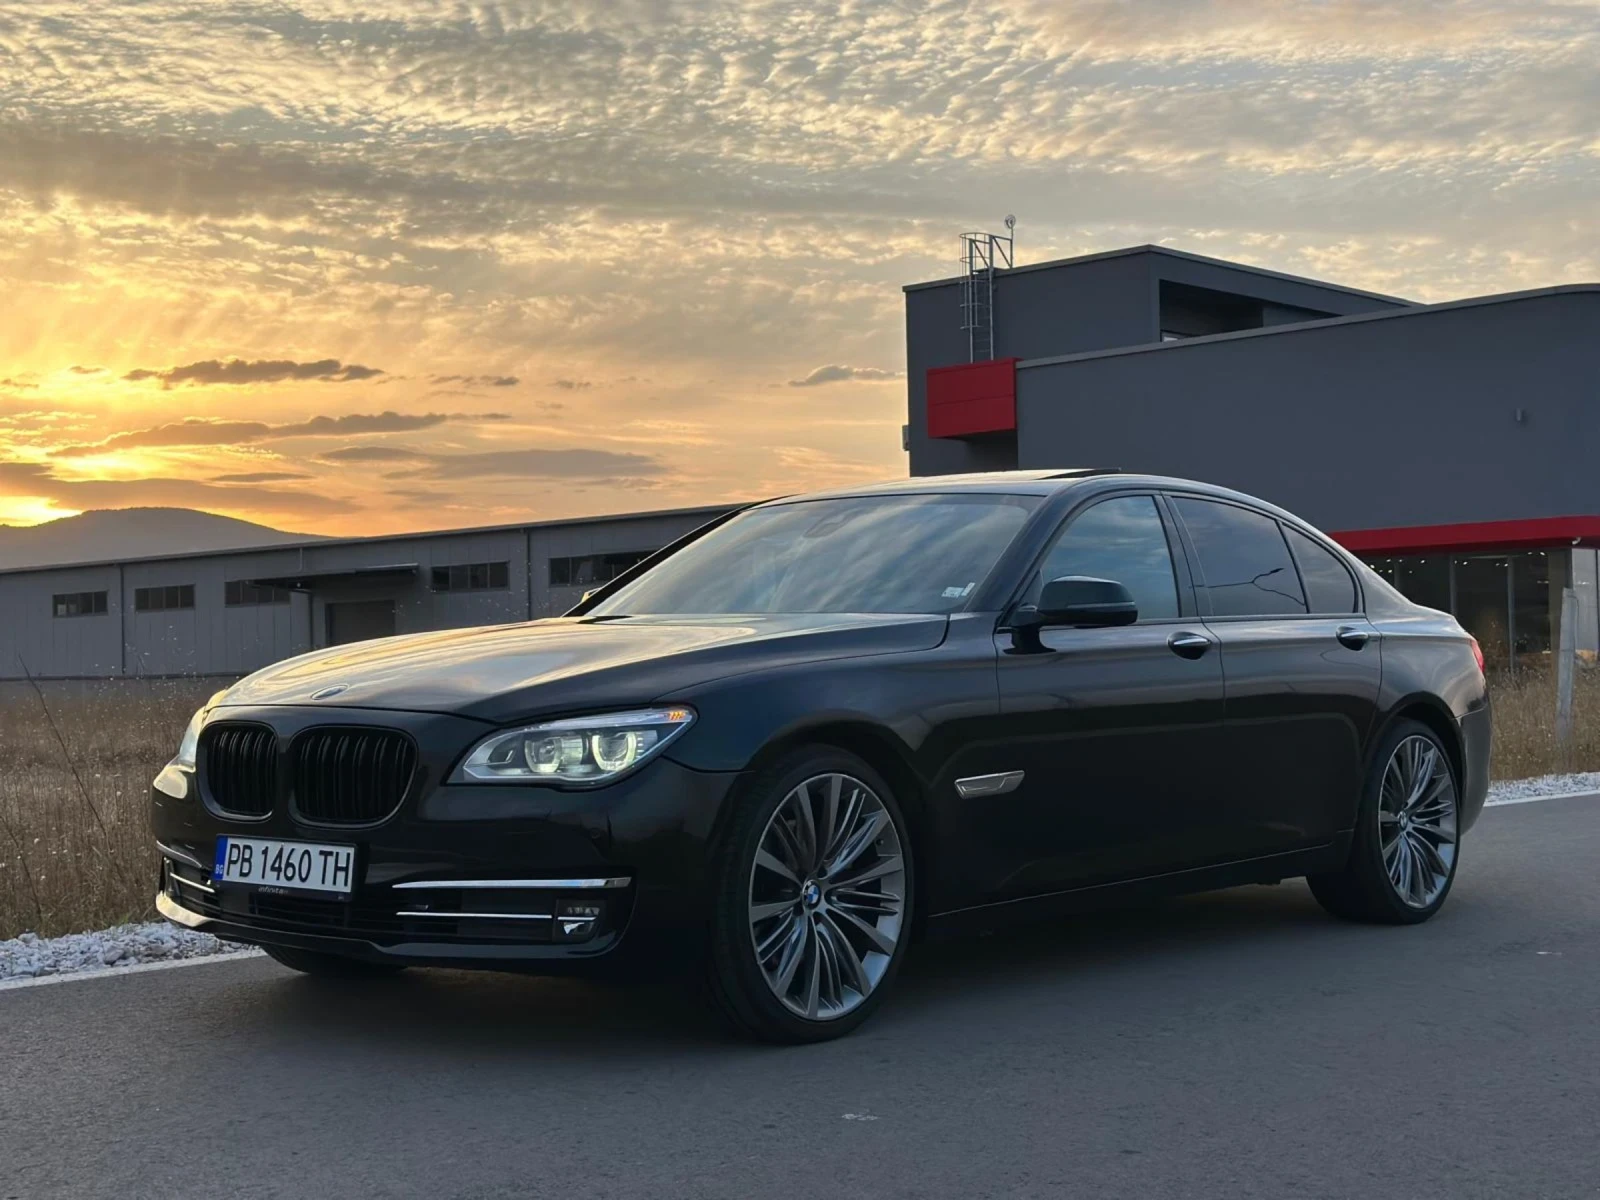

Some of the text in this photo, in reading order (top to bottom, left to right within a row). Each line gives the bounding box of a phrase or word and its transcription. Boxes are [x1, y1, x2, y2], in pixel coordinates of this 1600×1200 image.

[215, 864, 224, 875] BG
[226, 843, 351, 887] PB 1460 TH
